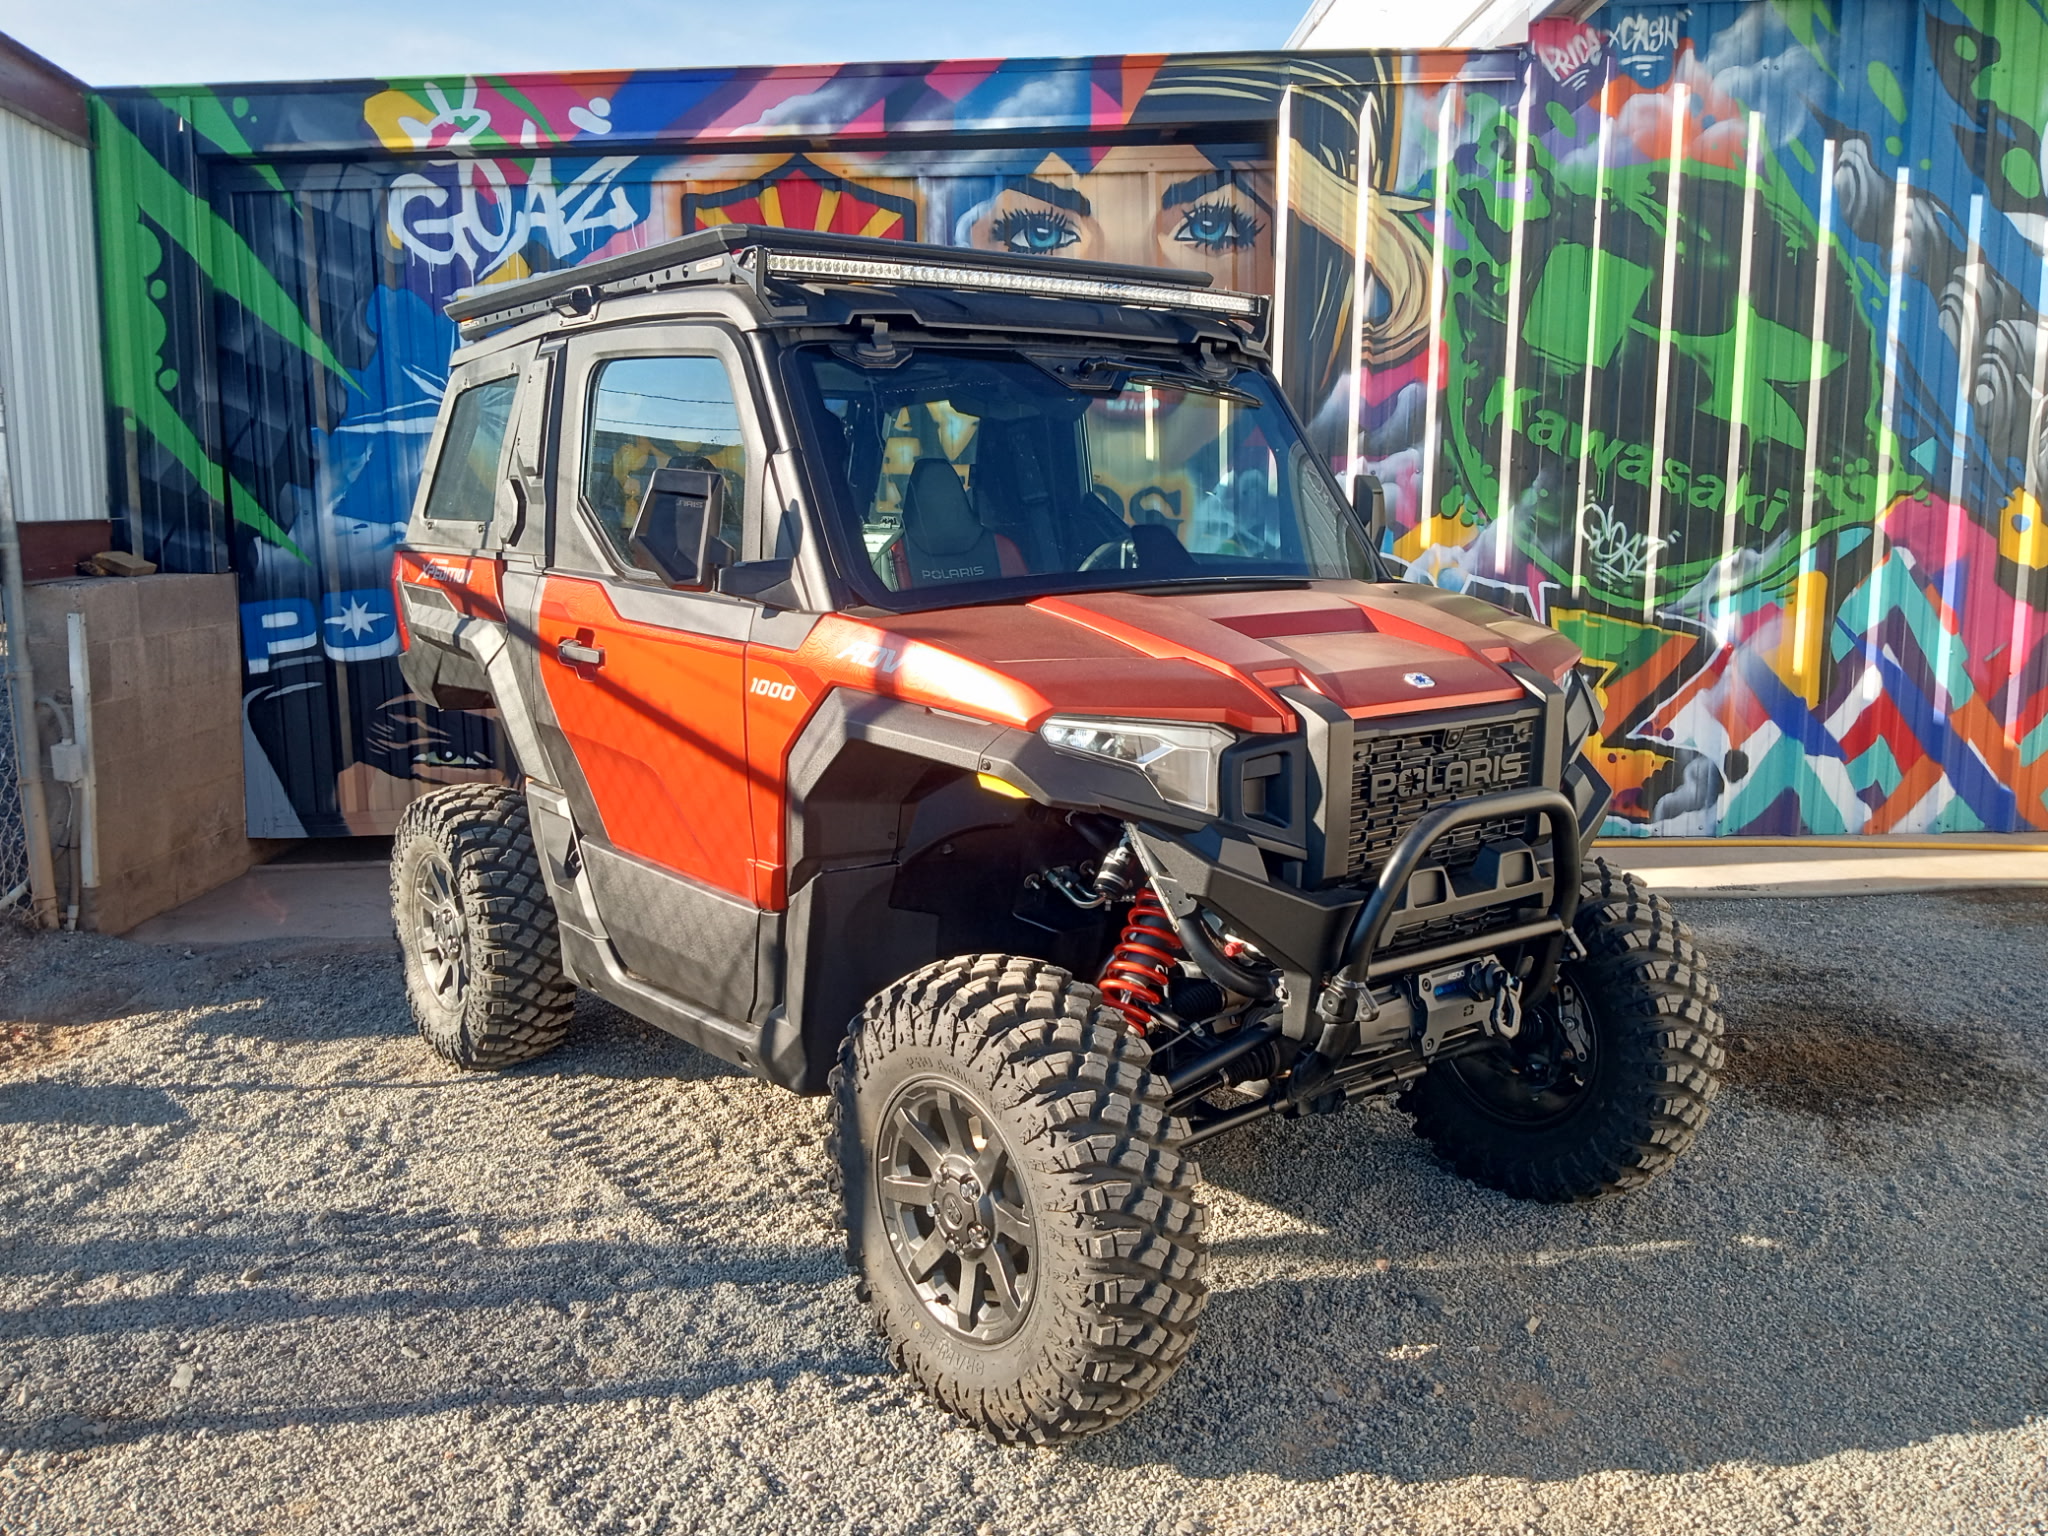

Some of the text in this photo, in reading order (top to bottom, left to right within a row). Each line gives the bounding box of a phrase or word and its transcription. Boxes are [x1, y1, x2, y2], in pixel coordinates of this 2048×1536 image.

[921, 565, 985, 580] POLARIS
[836, 640, 907, 674] ADV
[750, 677, 797, 702] 1000
[1370, 752, 1522, 801] POLARIS
